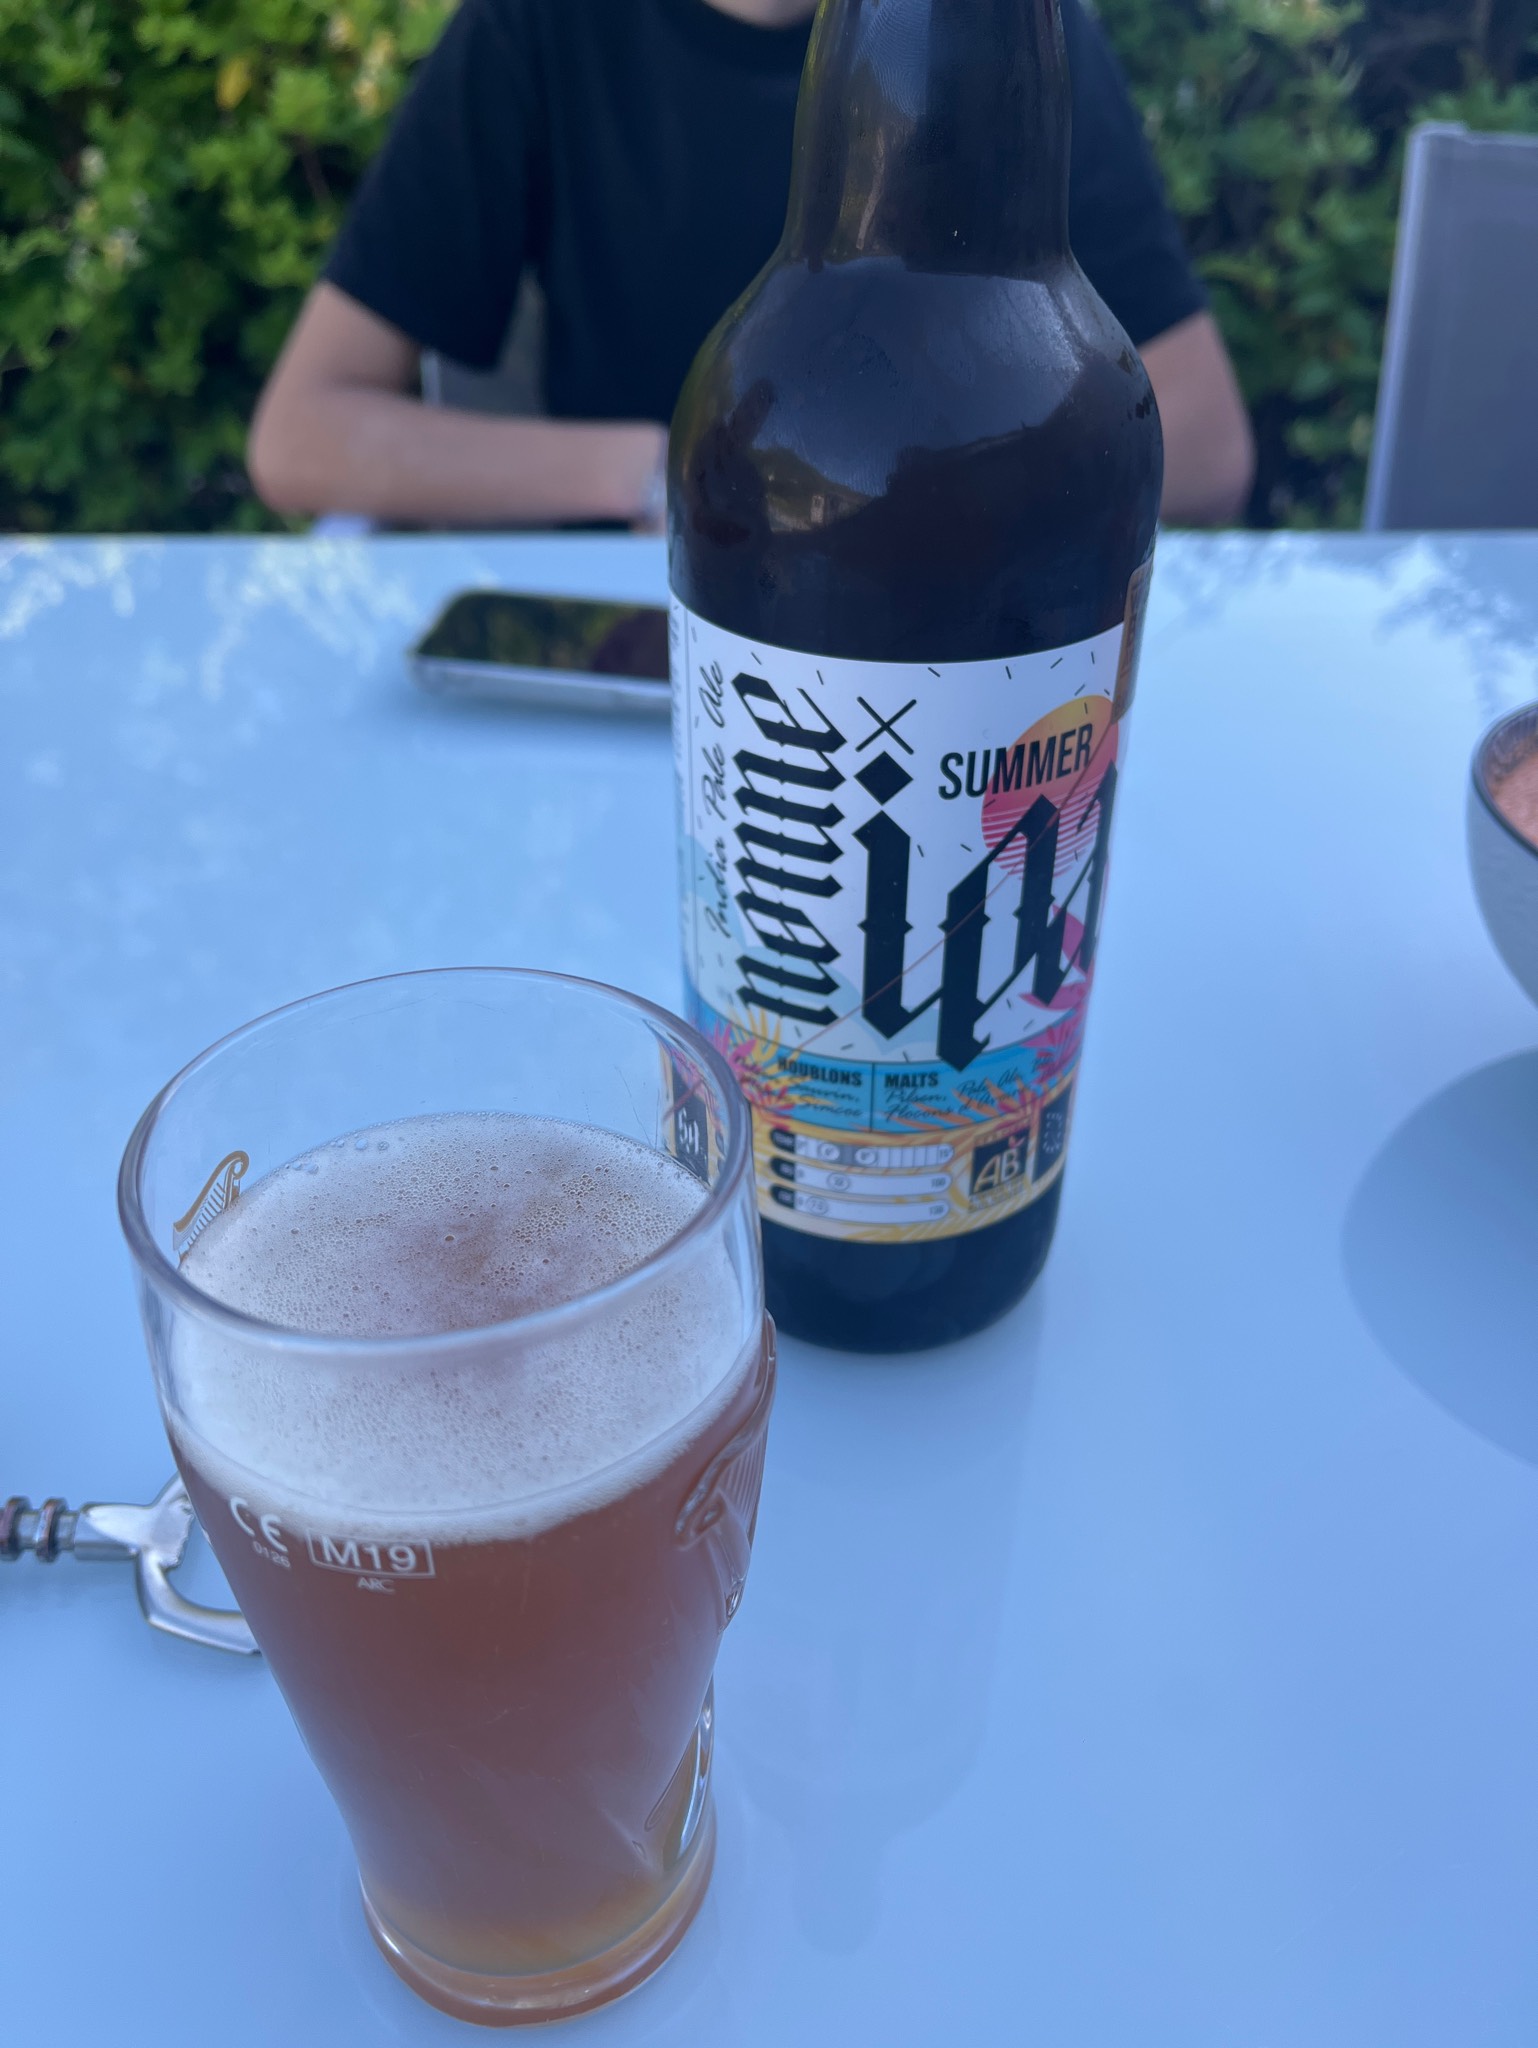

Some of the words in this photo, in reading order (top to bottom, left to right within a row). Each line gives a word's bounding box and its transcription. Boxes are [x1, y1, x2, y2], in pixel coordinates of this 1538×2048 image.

[699, 660, 727, 728] Ale
[700, 744, 728, 821] Pale
[938, 723, 1094, 800] SUMMER
[700, 836, 731, 939] India
[777, 1055, 863, 1088] HOUBLONS
[884, 1071, 939, 1089] MALTS
[974, 1148, 1020, 1194] AB
[320, 1533, 417, 1573] M19
[357, 1576, 396, 1595] ARC
